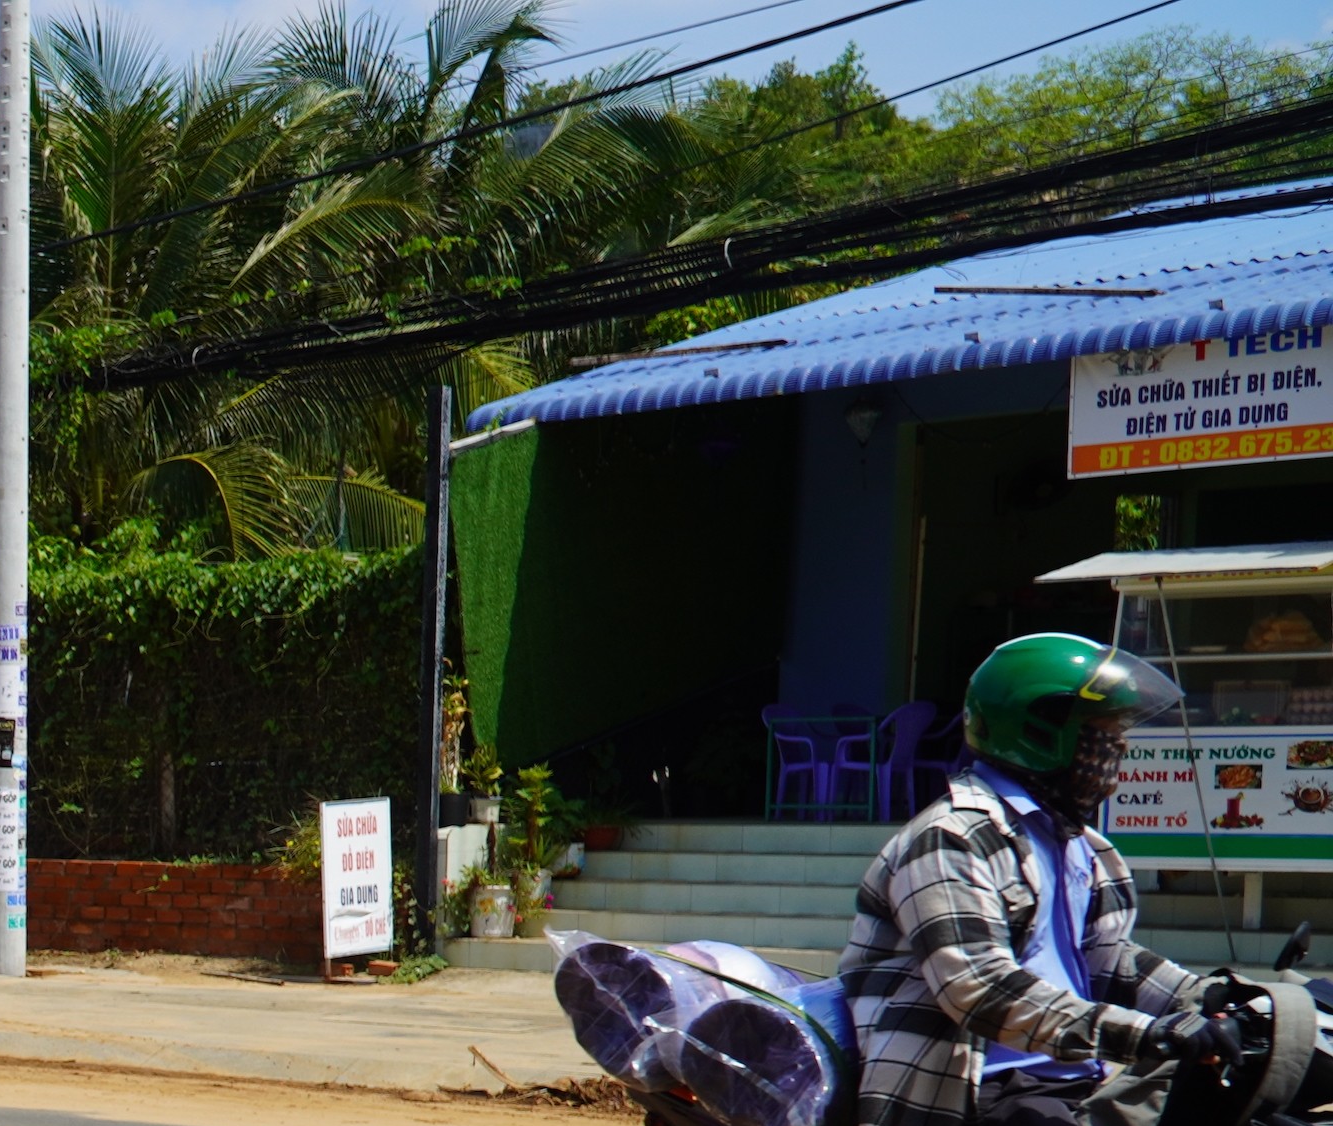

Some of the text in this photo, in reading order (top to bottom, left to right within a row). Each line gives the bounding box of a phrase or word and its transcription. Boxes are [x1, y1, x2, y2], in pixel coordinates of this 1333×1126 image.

[1224, 328, 1322, 358] TECH
[1097, 383, 1131, 408] SỬA
[1138, 378, 1185, 404] CHỮA
[1192, 370, 1241, 399] THIẾT
[1247, 373, 1266, 396] BỊ
[1126, 402, 1288, 438] ĐIỆN TỬ GIA DỤNG
[1161, 747, 1203, 763] THỊT
[1209, 743, 1276, 759] NƯỚNG
[1117, 768, 1195, 782] BÁNH MÌ
[1116, 790, 1163, 805] CAFÉ
[337, 811, 377, 838] SỬA CHỮA
[1115, 811, 1188, 827] SINH TỐ
[356, 846, 375, 874] ĐIỆN
[340, 884, 378, 907] GIA DỤNG
